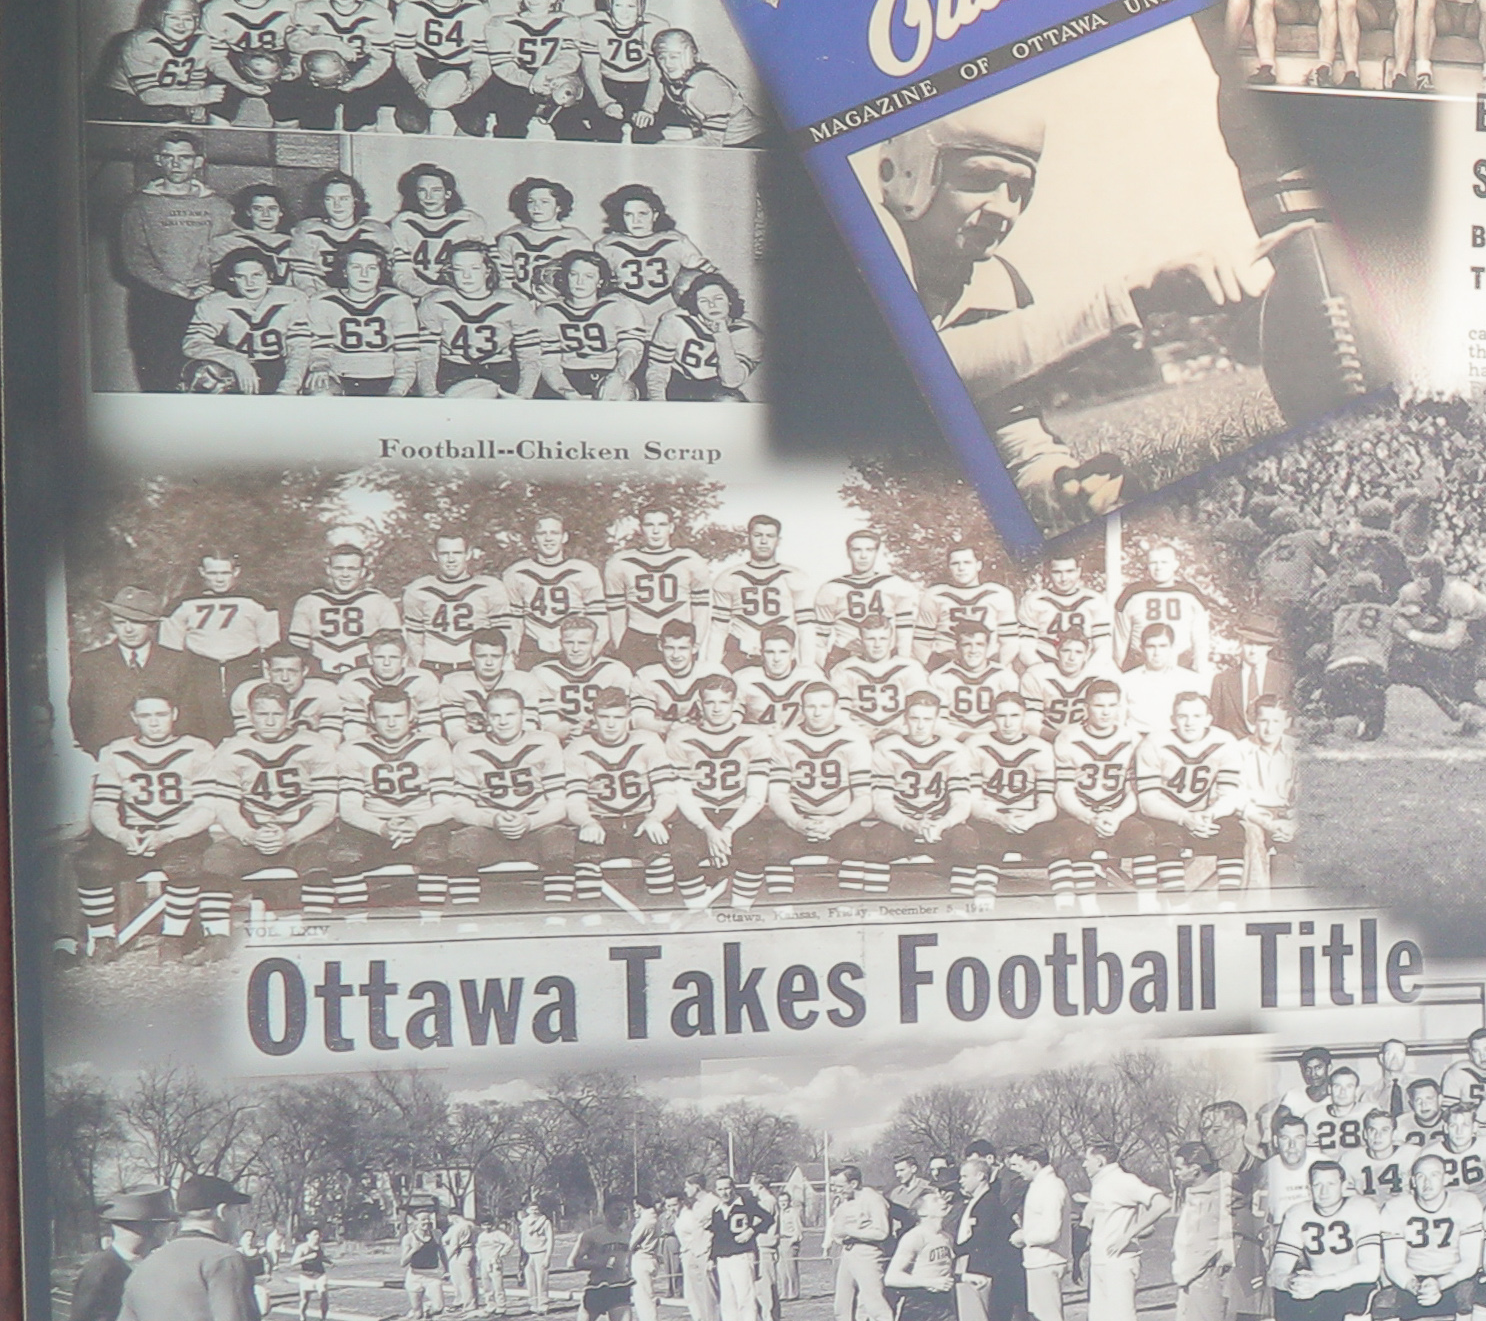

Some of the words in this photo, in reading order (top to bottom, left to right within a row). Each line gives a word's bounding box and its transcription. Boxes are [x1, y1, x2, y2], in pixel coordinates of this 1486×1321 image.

[808, 79, 937, 144] MAGAZINE
[960, 57, 991, 82] OF
[1011, 13, 1109, 61] OTTAWA
[381, 437, 628, 461] Football--Chicken
[644, 439, 721, 466] Scrap
[246, 956, 578, 1058] Ottawa
[610, 943, 867, 1039] Takes
[898, 924, 1217, 1026] Football
[1246, 917, 1425, 1009] Title
[1301, 1221, 1354, 1256] 33
[1406, 1216, 1454, 1249] 37
